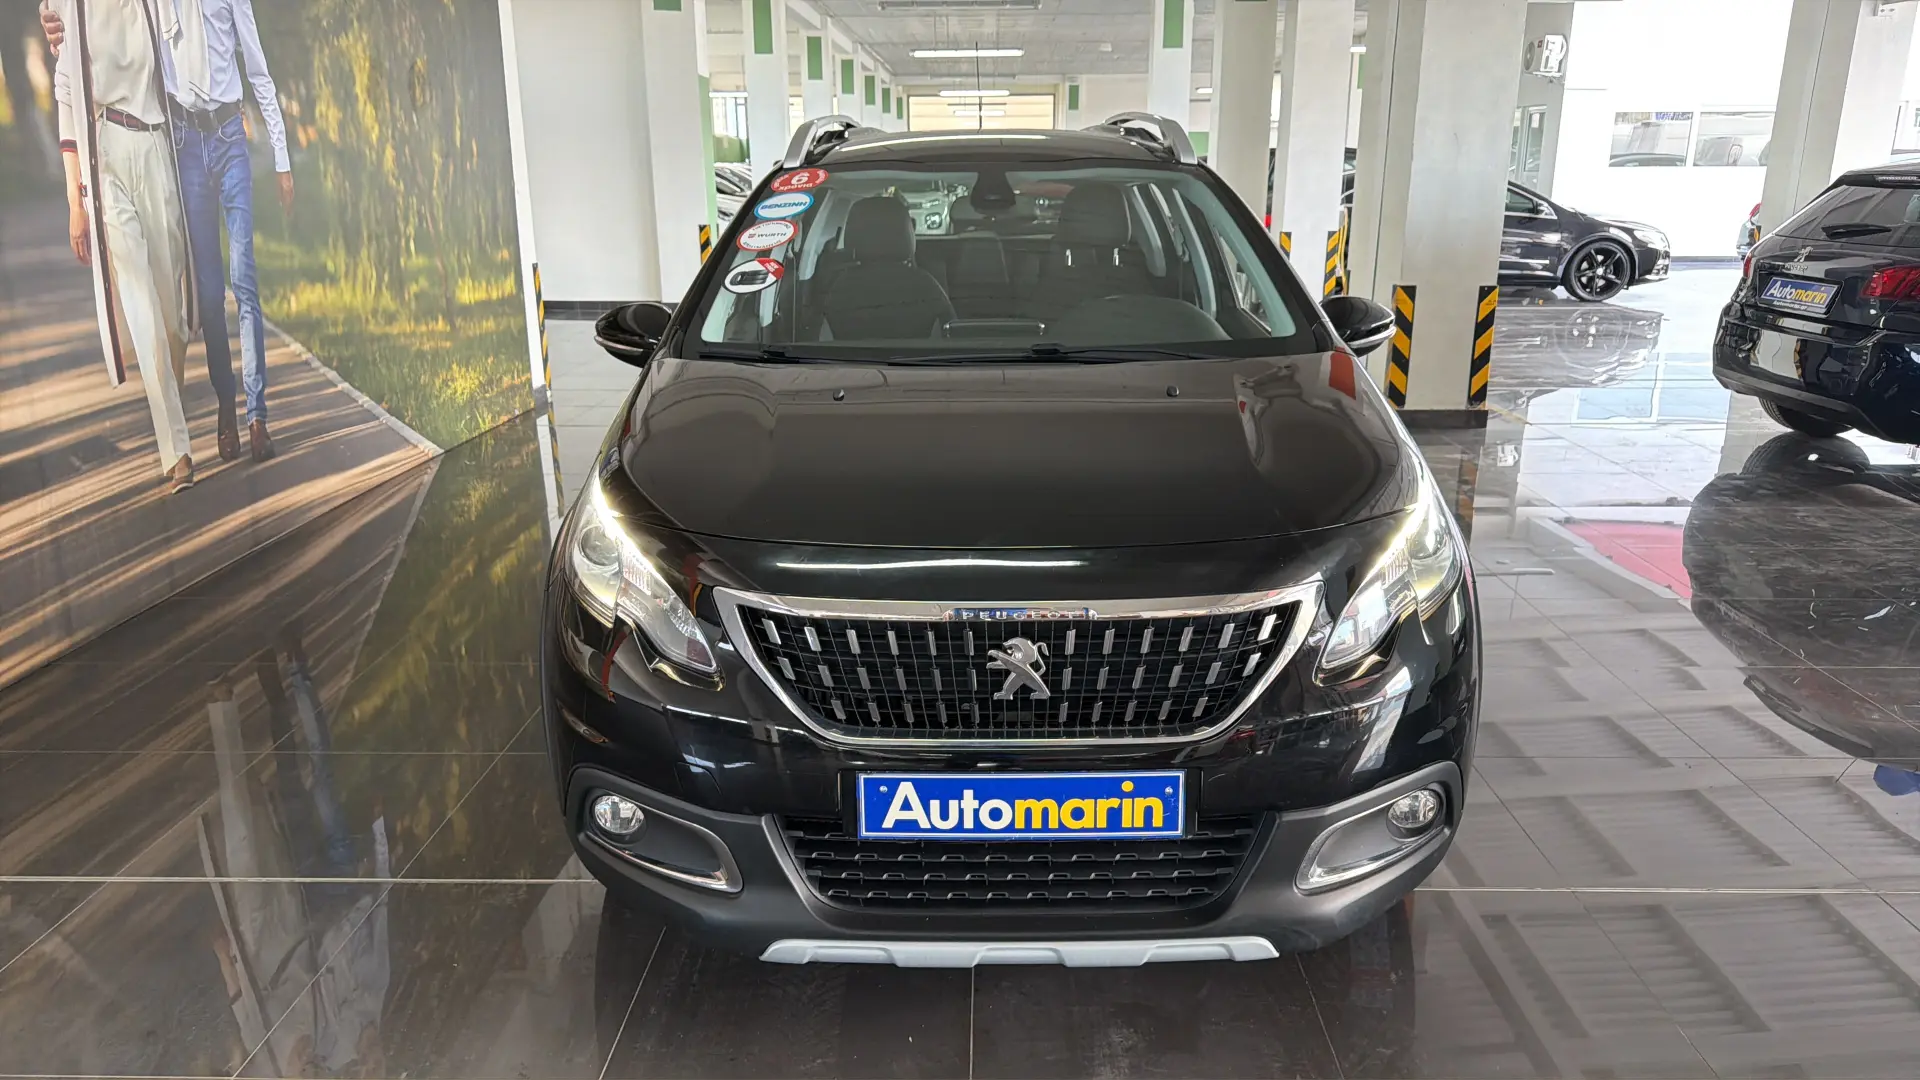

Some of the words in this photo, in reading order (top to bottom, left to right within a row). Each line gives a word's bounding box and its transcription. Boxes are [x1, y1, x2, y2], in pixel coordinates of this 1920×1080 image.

[791, 172, 810, 185] 6
[1766, 280, 1828, 304] Automarin
[962, 609, 1078, 621] PEUGEOT
[881, 780, 1163, 830] Automarin
